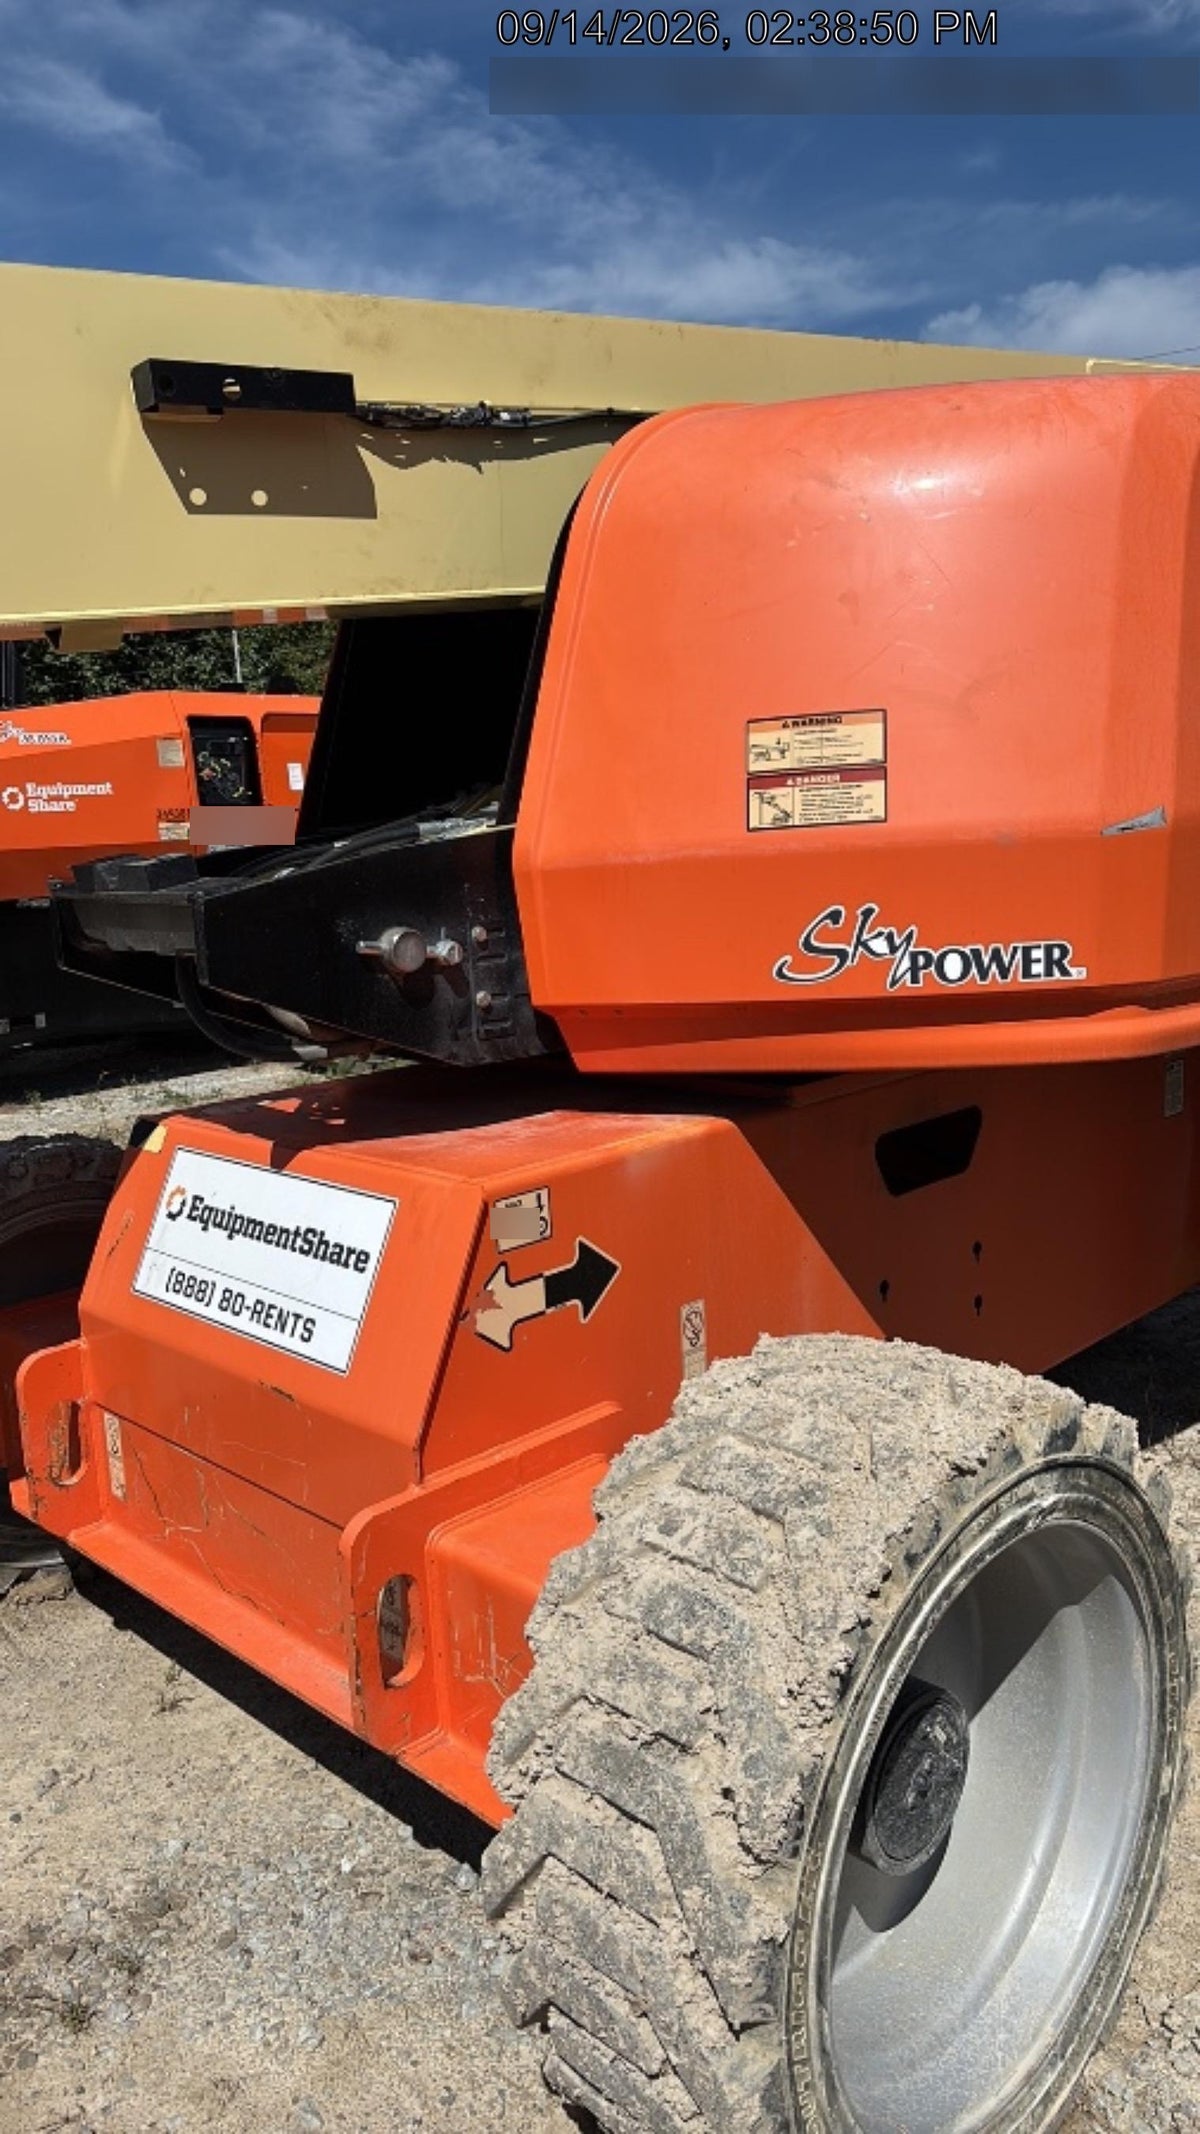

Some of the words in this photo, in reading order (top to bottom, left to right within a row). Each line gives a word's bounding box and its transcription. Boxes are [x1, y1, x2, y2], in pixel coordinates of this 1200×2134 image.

[791, 716, 842, 728] WARNING
[796, 773, 840, 785] DANGER
[26, 782, 113, 799] Equipment
[28, 799, 76, 813] Share
[187, 1194, 371, 1274] EquipmentShare
[165, 1268, 217, 1307] (888)
[218, 1287, 317, 1343] 80-RENTS
